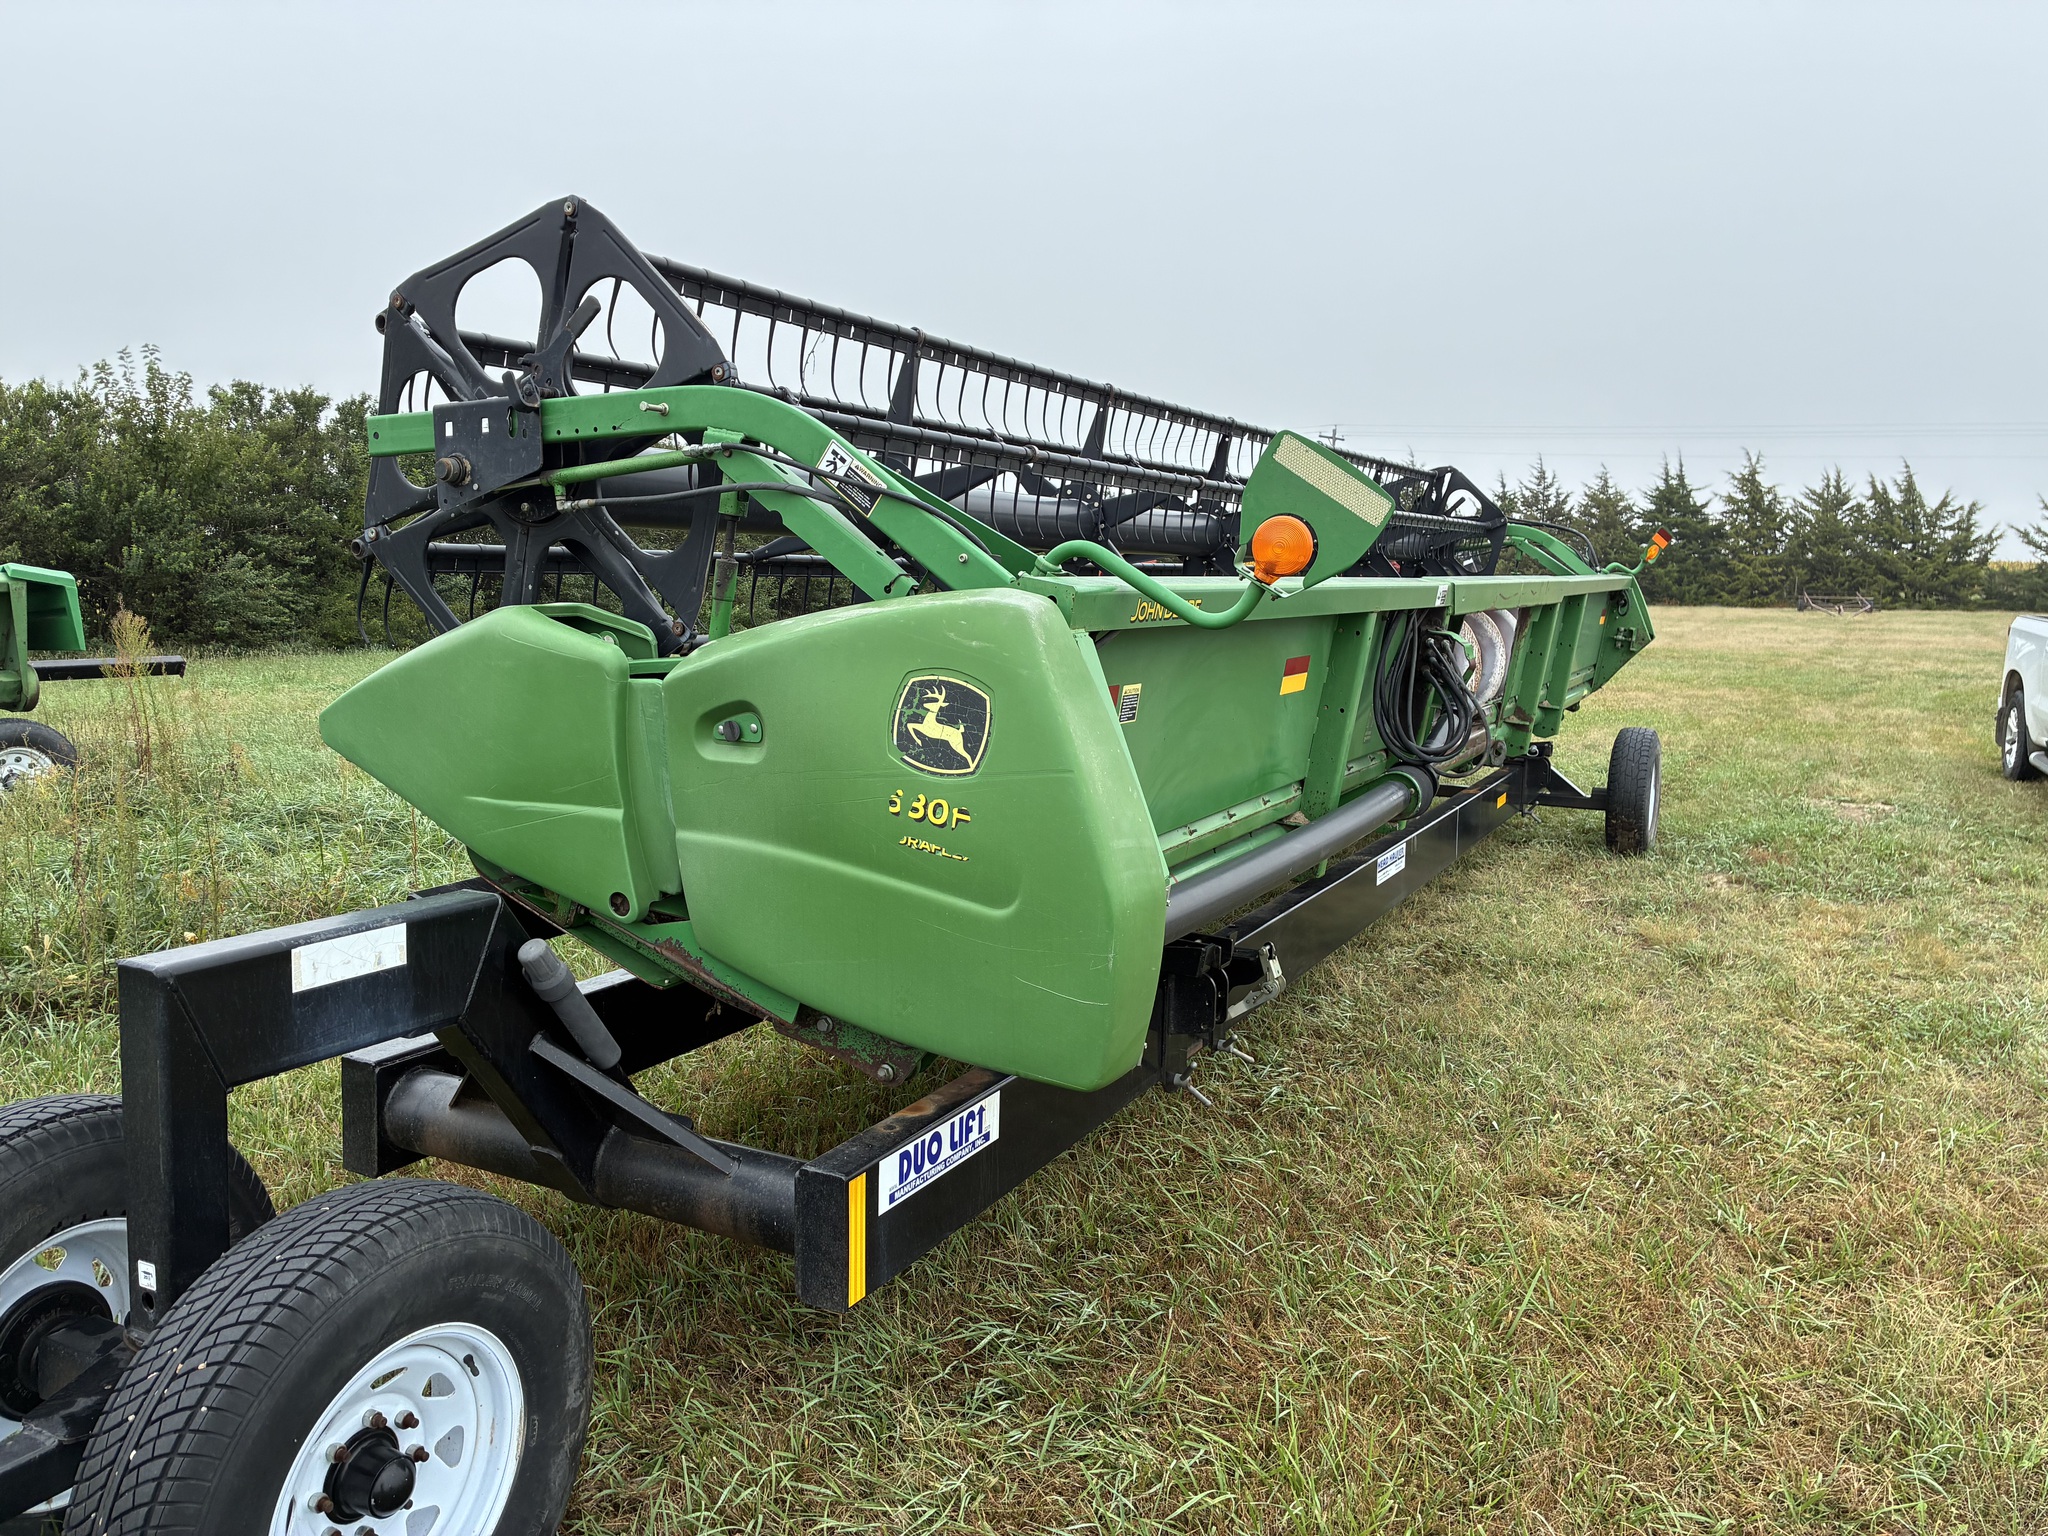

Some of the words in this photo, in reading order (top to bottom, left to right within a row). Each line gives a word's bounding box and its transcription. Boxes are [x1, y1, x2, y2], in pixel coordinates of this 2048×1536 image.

[1130, 597, 1164, 622] JOHN
[898, 1130, 943, 1187] DUO
[949, 1104, 986, 1152] LIFT
[894, 1163, 946, 1201] MANUFACTURING
[504, 1278, 543, 1312] RADIAL
